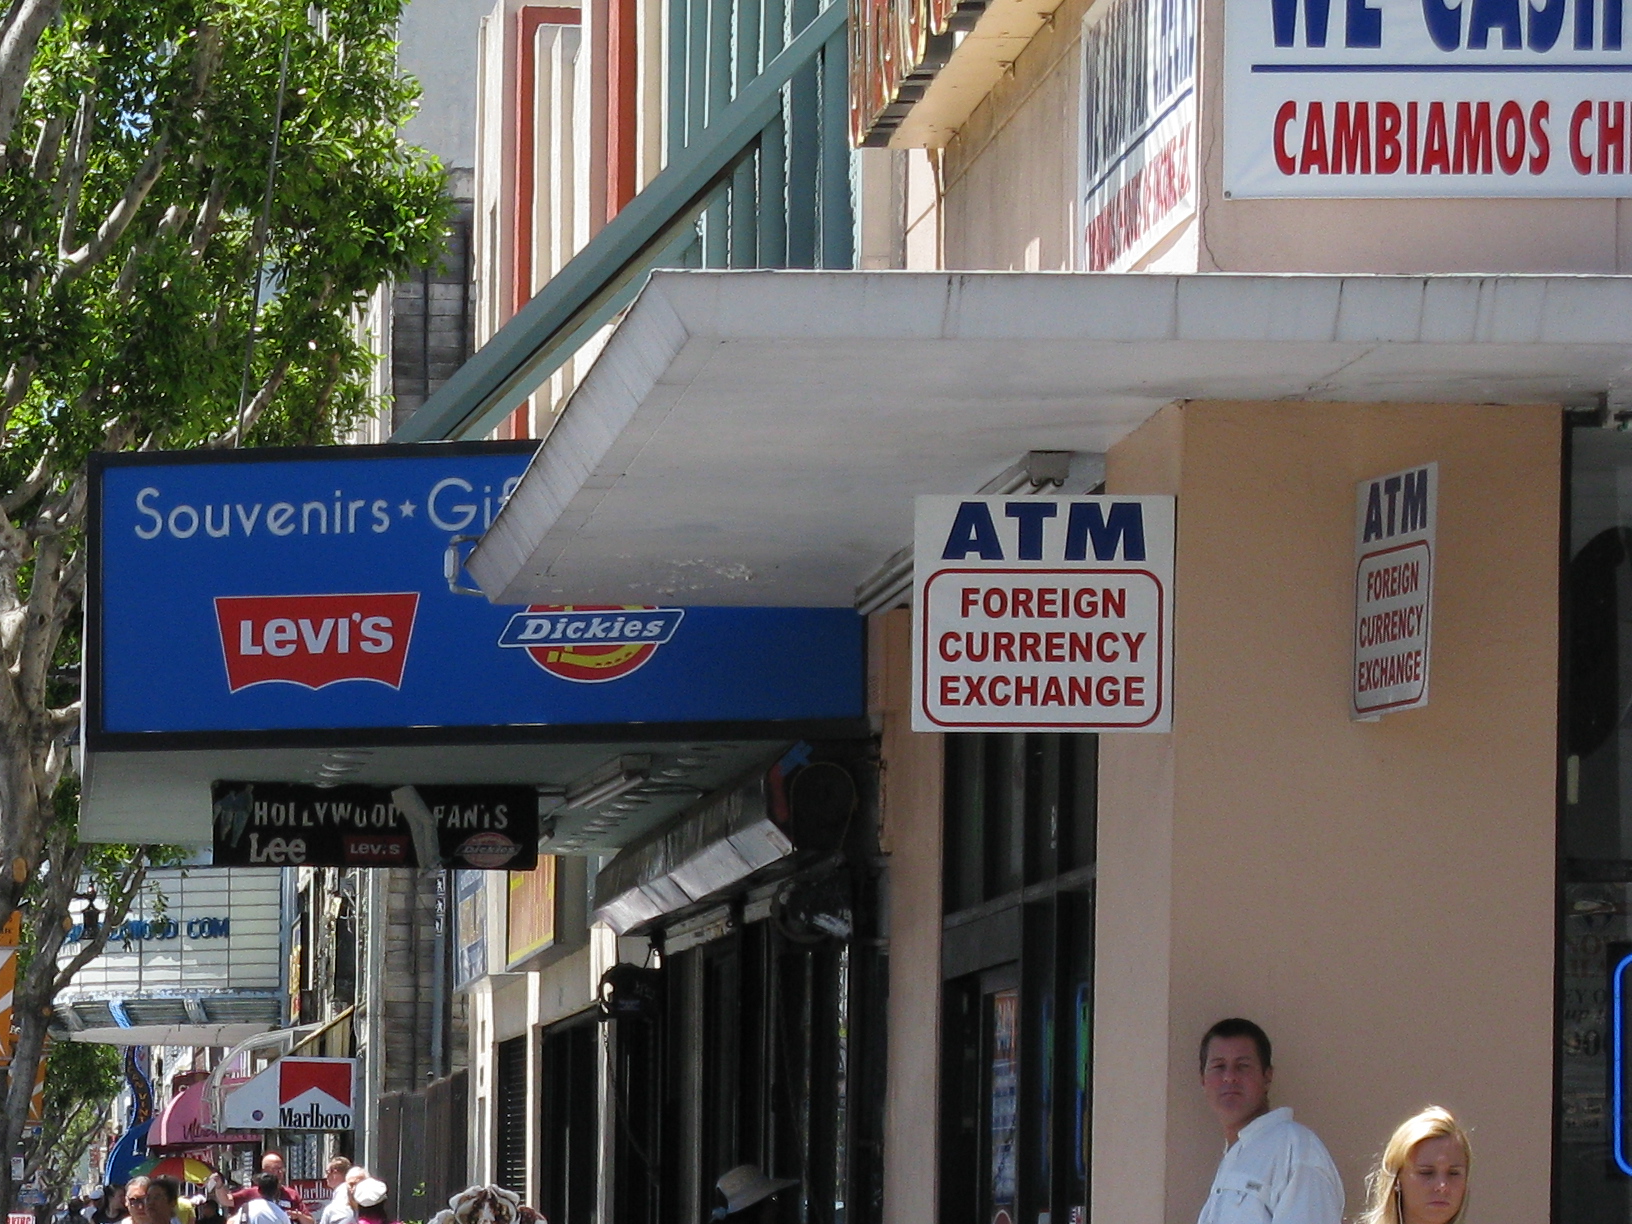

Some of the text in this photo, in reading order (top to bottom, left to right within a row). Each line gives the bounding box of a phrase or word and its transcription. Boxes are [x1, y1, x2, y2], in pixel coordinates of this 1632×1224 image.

[1273, 100, 1632, 176] CAMBIAMOS CH
[135, 487, 390, 539] Souvenirs
[1364, 468, 1428, 543] ATM
[942, 501, 1147, 562] ATM
[1367, 561, 1420, 602] FOREIGN
[960, 588, 1127, 619] FOREIGN
[517, 617, 665, 640] Dickies
[1359, 604, 1424, 648] CURRENCY
[938, 631, 1147, 663] CURRENCY
[1358, 650, 1422, 692] EXCHANGE
[939, 675, 1146, 707] EXCHANGE
[249, 832, 306, 863] Lee
[187, 917, 230, 938] COM
[279, 1103, 351, 1129] Marlboro
